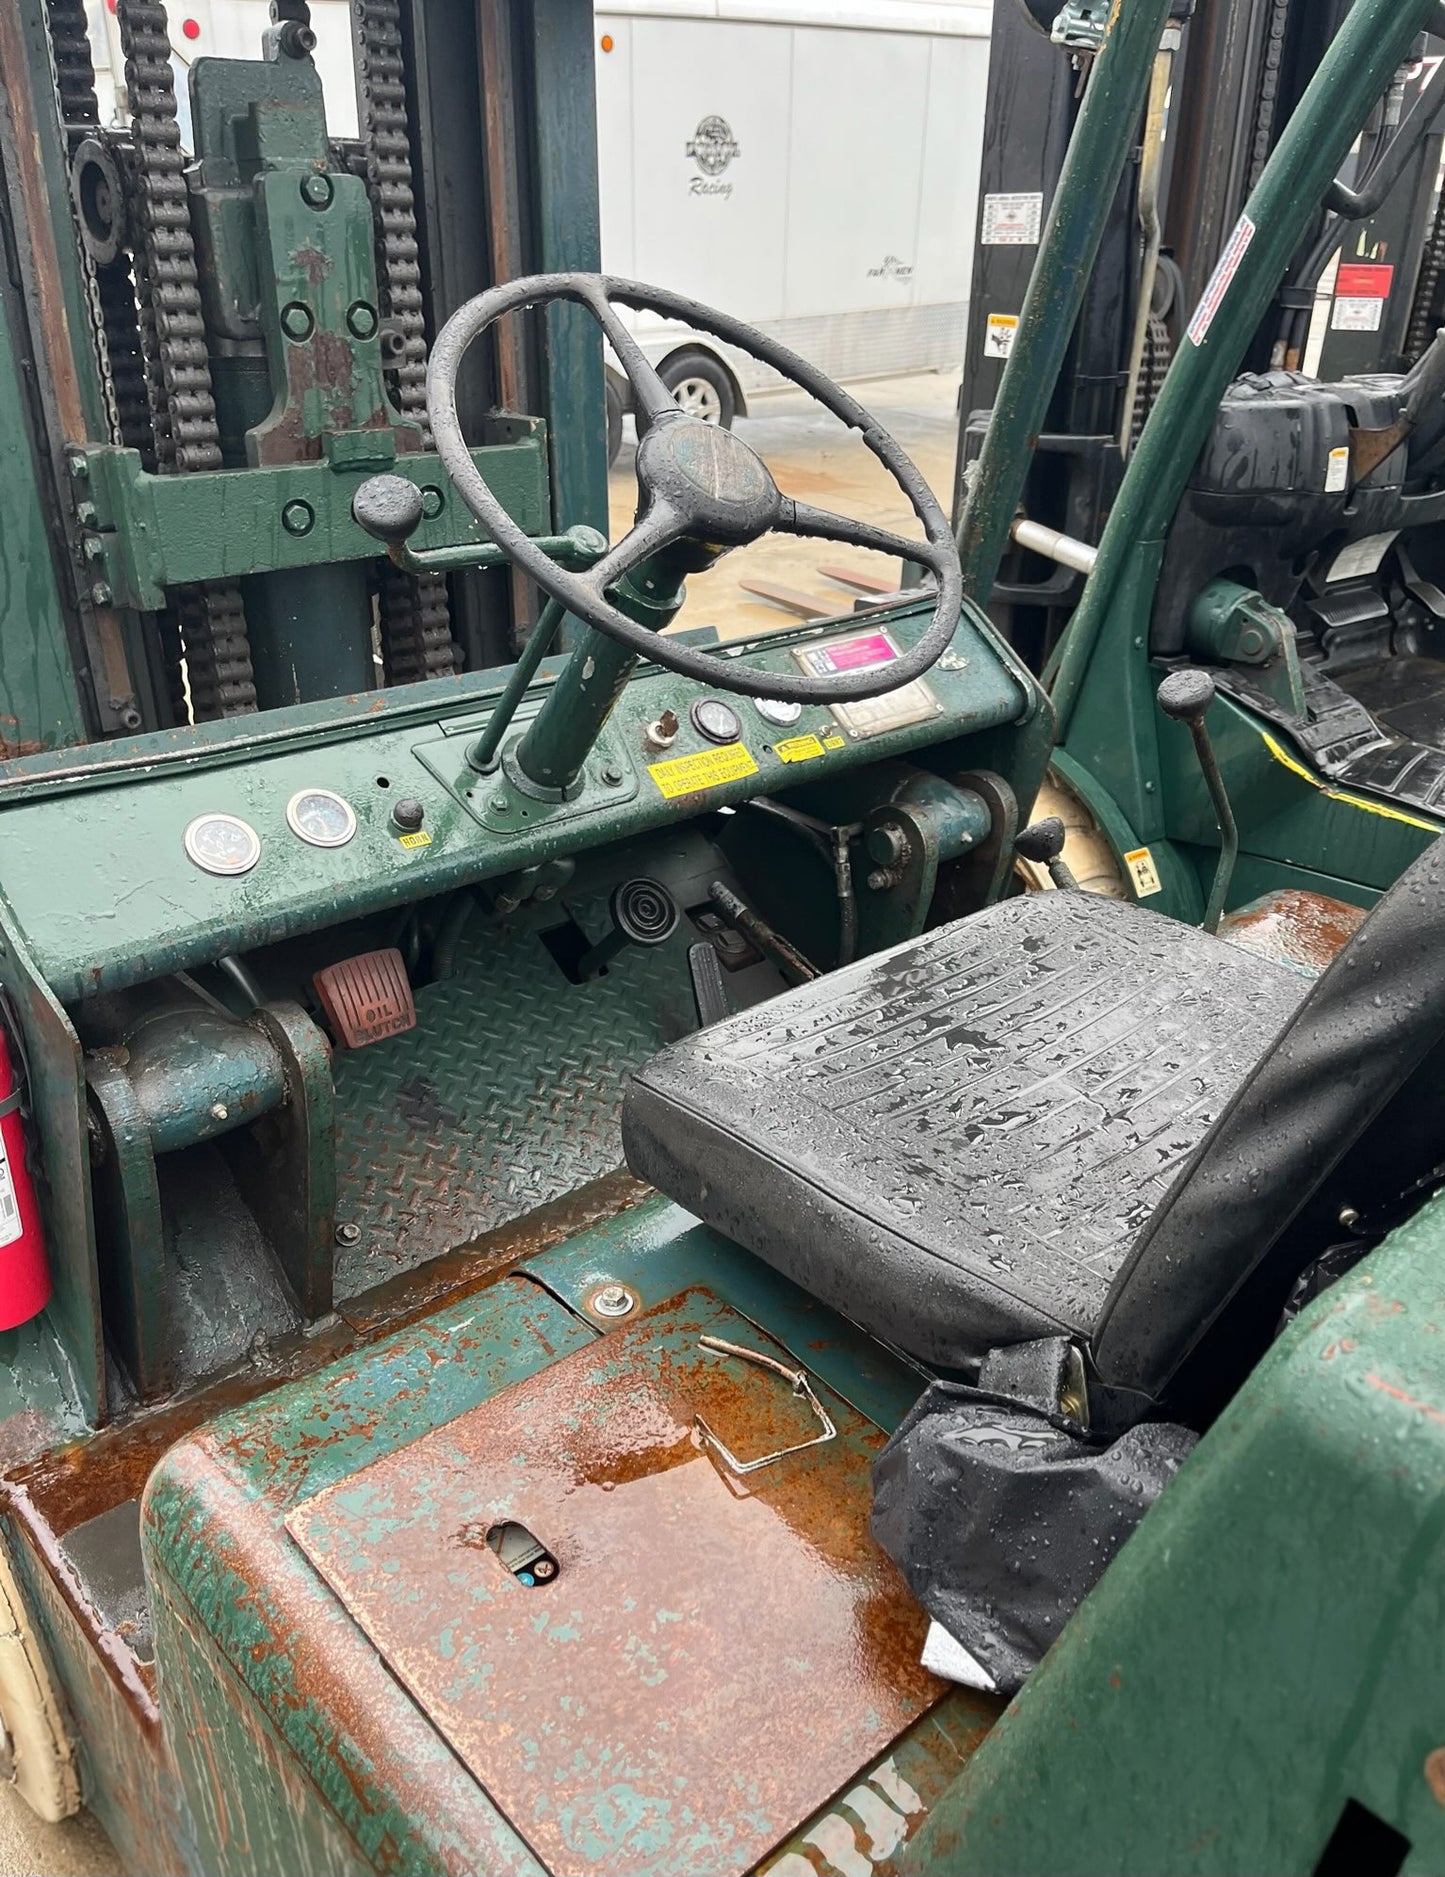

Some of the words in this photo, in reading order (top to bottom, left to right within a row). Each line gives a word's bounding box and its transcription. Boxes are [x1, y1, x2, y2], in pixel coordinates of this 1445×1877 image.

[655, 766, 674, 779] DAILY
[675, 756, 715, 774] INSPECTION
[712, 747, 745, 764] REQUIRED
[662, 782, 673, 794] TO
[674, 774, 704, 791] OPERATE
[703, 769, 720, 782] THIS
[718, 760, 753, 779] EQUIPMENT
[402, 833, 428, 847] HORN
[366, 1004, 393, 1022] OIL
[353, 1014, 410, 1043] CLUTCH
